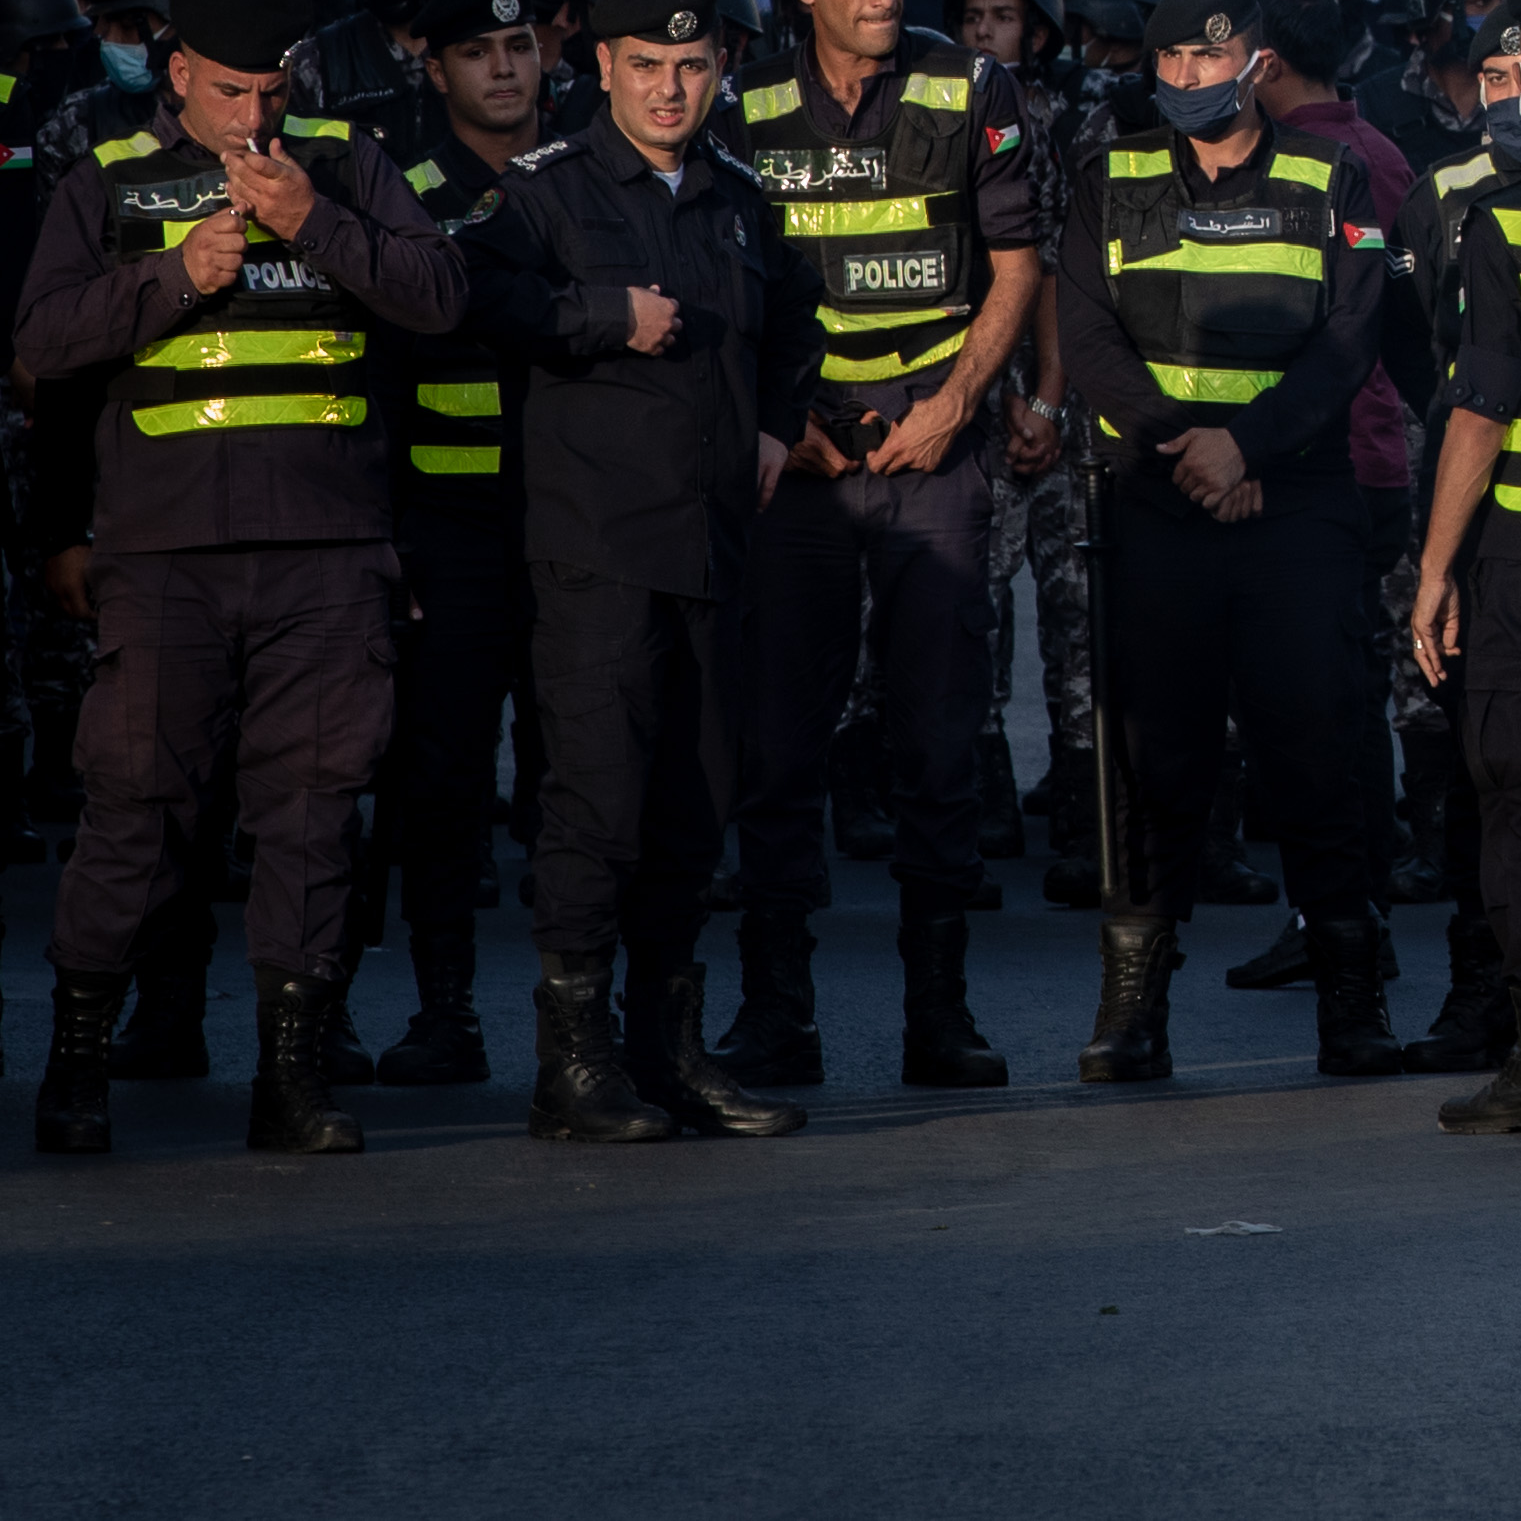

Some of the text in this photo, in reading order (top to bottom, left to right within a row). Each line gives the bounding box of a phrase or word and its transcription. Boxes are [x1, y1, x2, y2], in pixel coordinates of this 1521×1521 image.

[760, 156, 880, 188] الشرطة
[123, 182, 230, 212] شرطة
[1188, 215, 1270, 234] الشرطة
[243, 261, 332, 290] POLICE
[849, 258, 938, 290] POLICE
